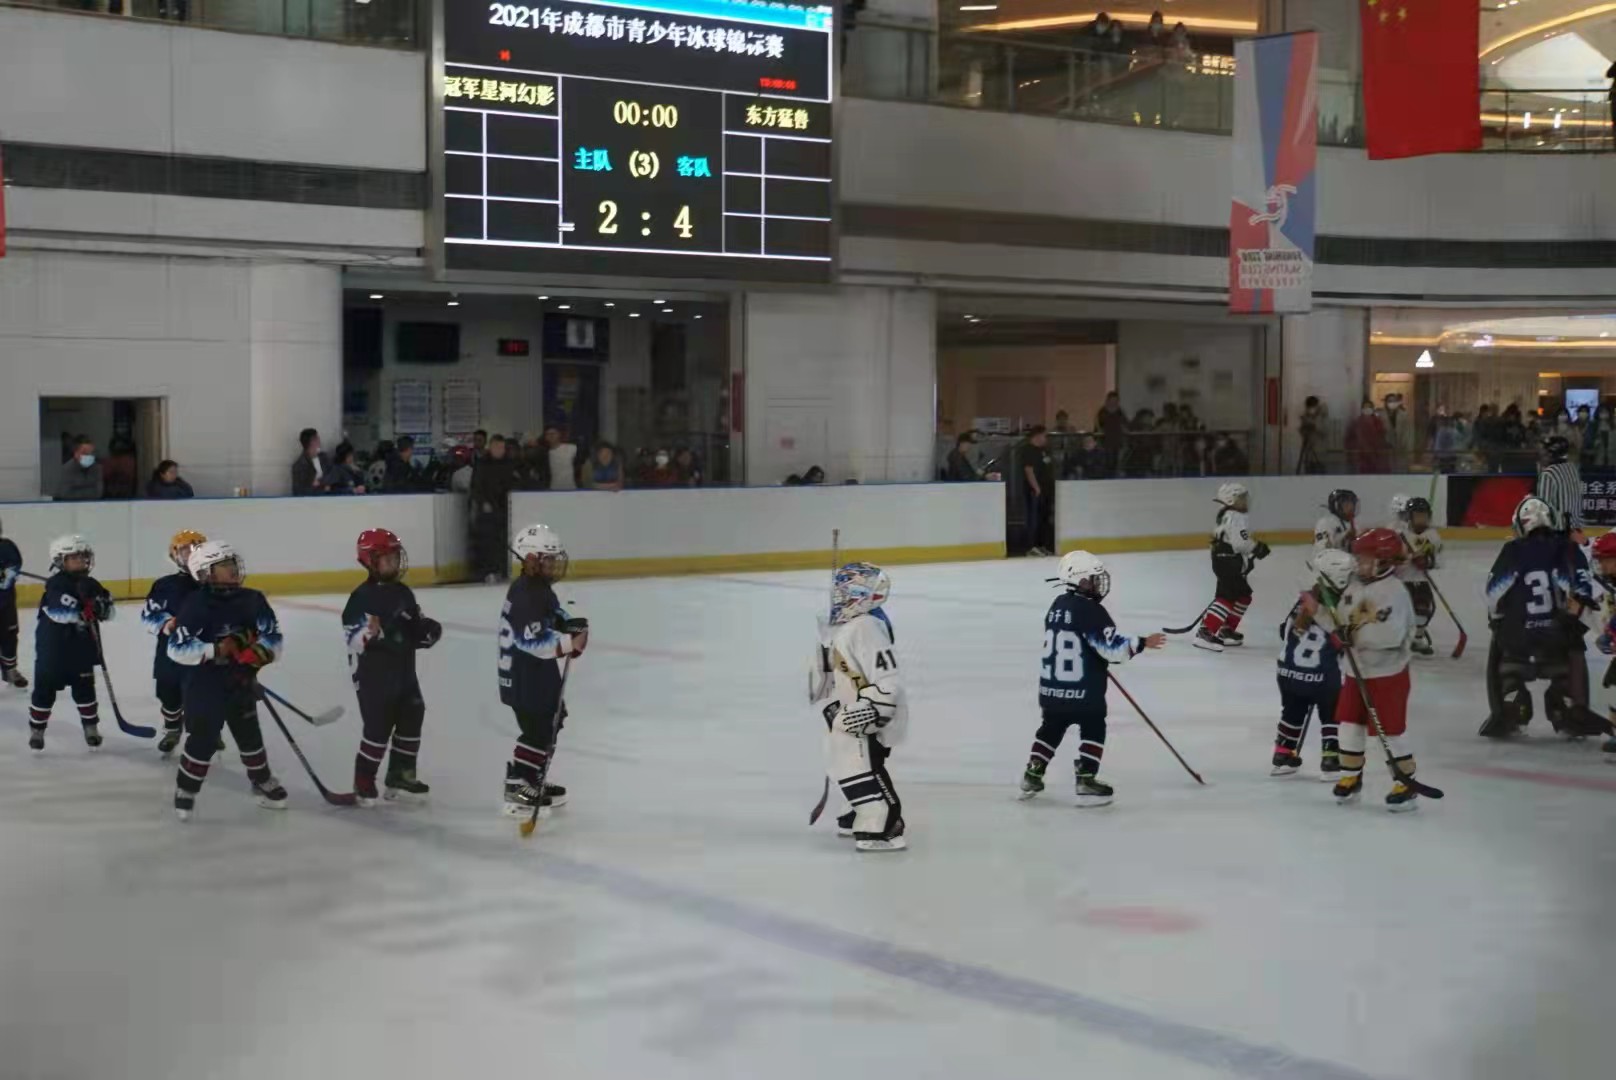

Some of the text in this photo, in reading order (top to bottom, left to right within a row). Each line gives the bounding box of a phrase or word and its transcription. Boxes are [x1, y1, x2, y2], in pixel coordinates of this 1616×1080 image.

[489, 3, 784, 58] 2021年成都市青少年冰球锦标赛
[613, 100, 678, 128] 00:00
[745, 104, 809, 129] 东方猛兽
[574, 147, 613, 172] 主队
[629, 150, 660, 179] (3)
[676, 155, 712, 178] 客队
[875, 649, 897, 671] 41
[1040, 629, 1085, 681] 28
